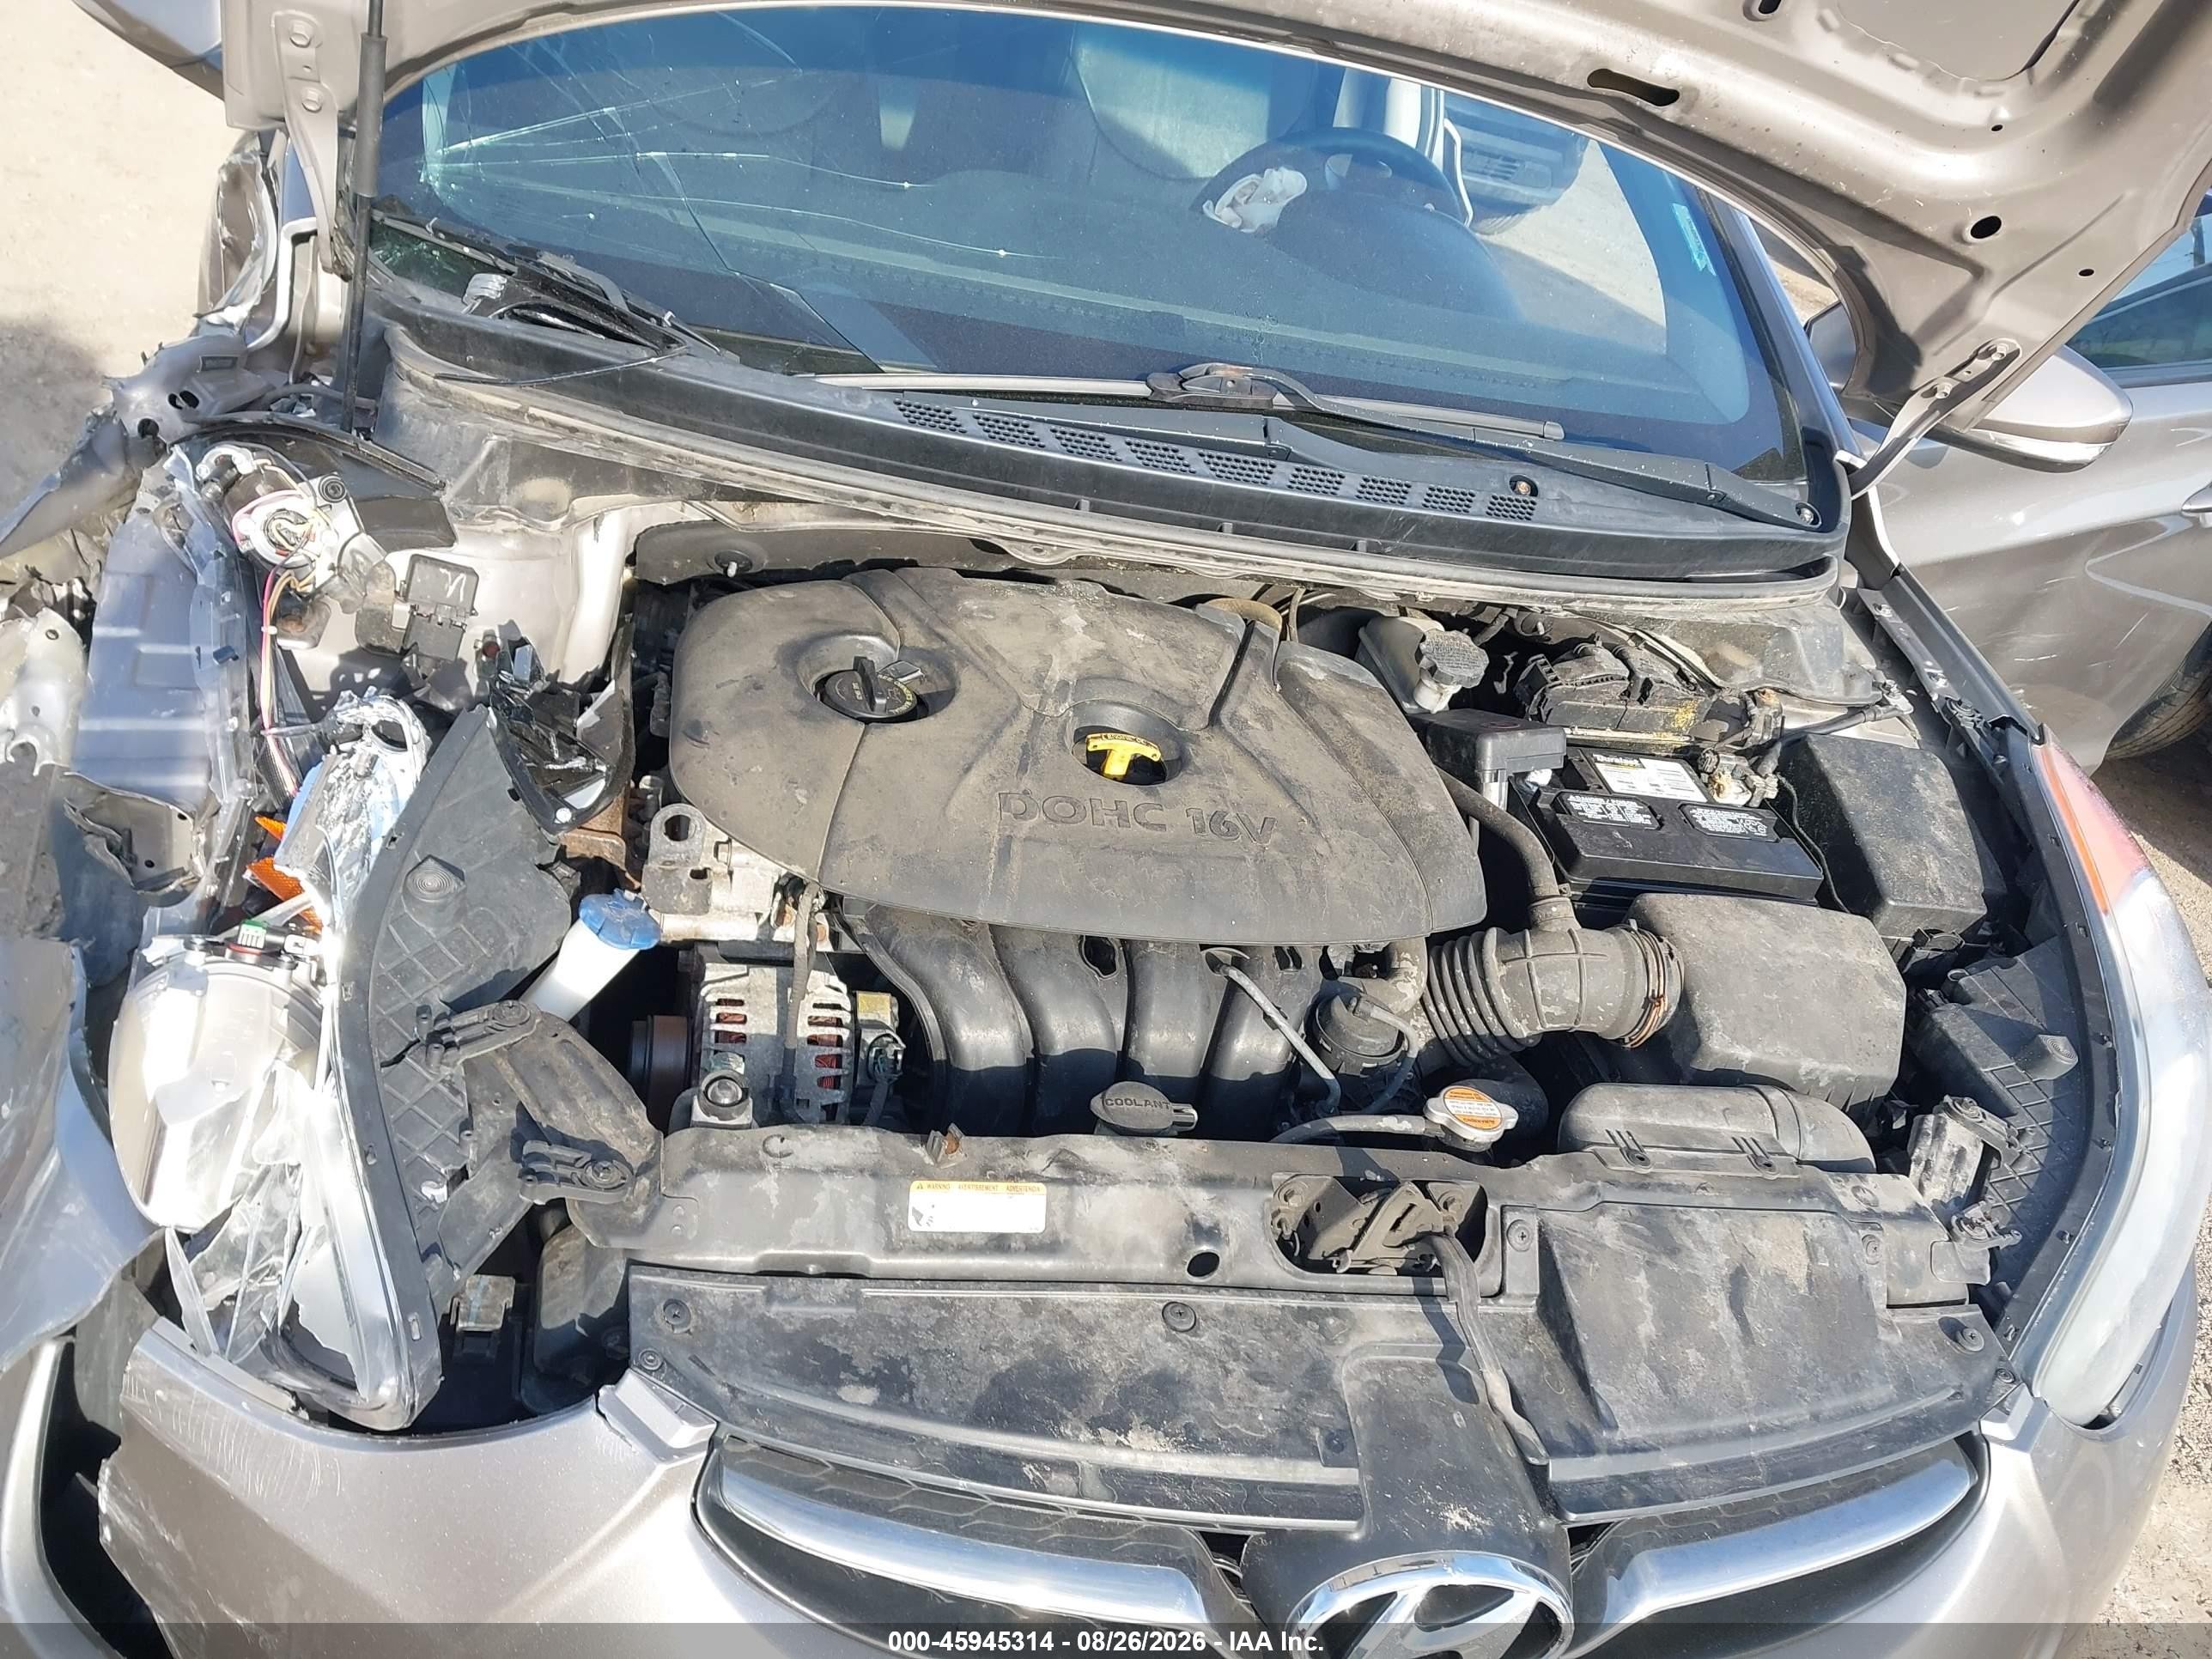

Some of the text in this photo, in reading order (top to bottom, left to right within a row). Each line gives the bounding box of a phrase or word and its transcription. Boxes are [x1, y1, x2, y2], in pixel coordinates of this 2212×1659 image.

[998, 792, 1278, 845] DOHC 16V
[1104, 1097, 1170, 1109] COOLANT
